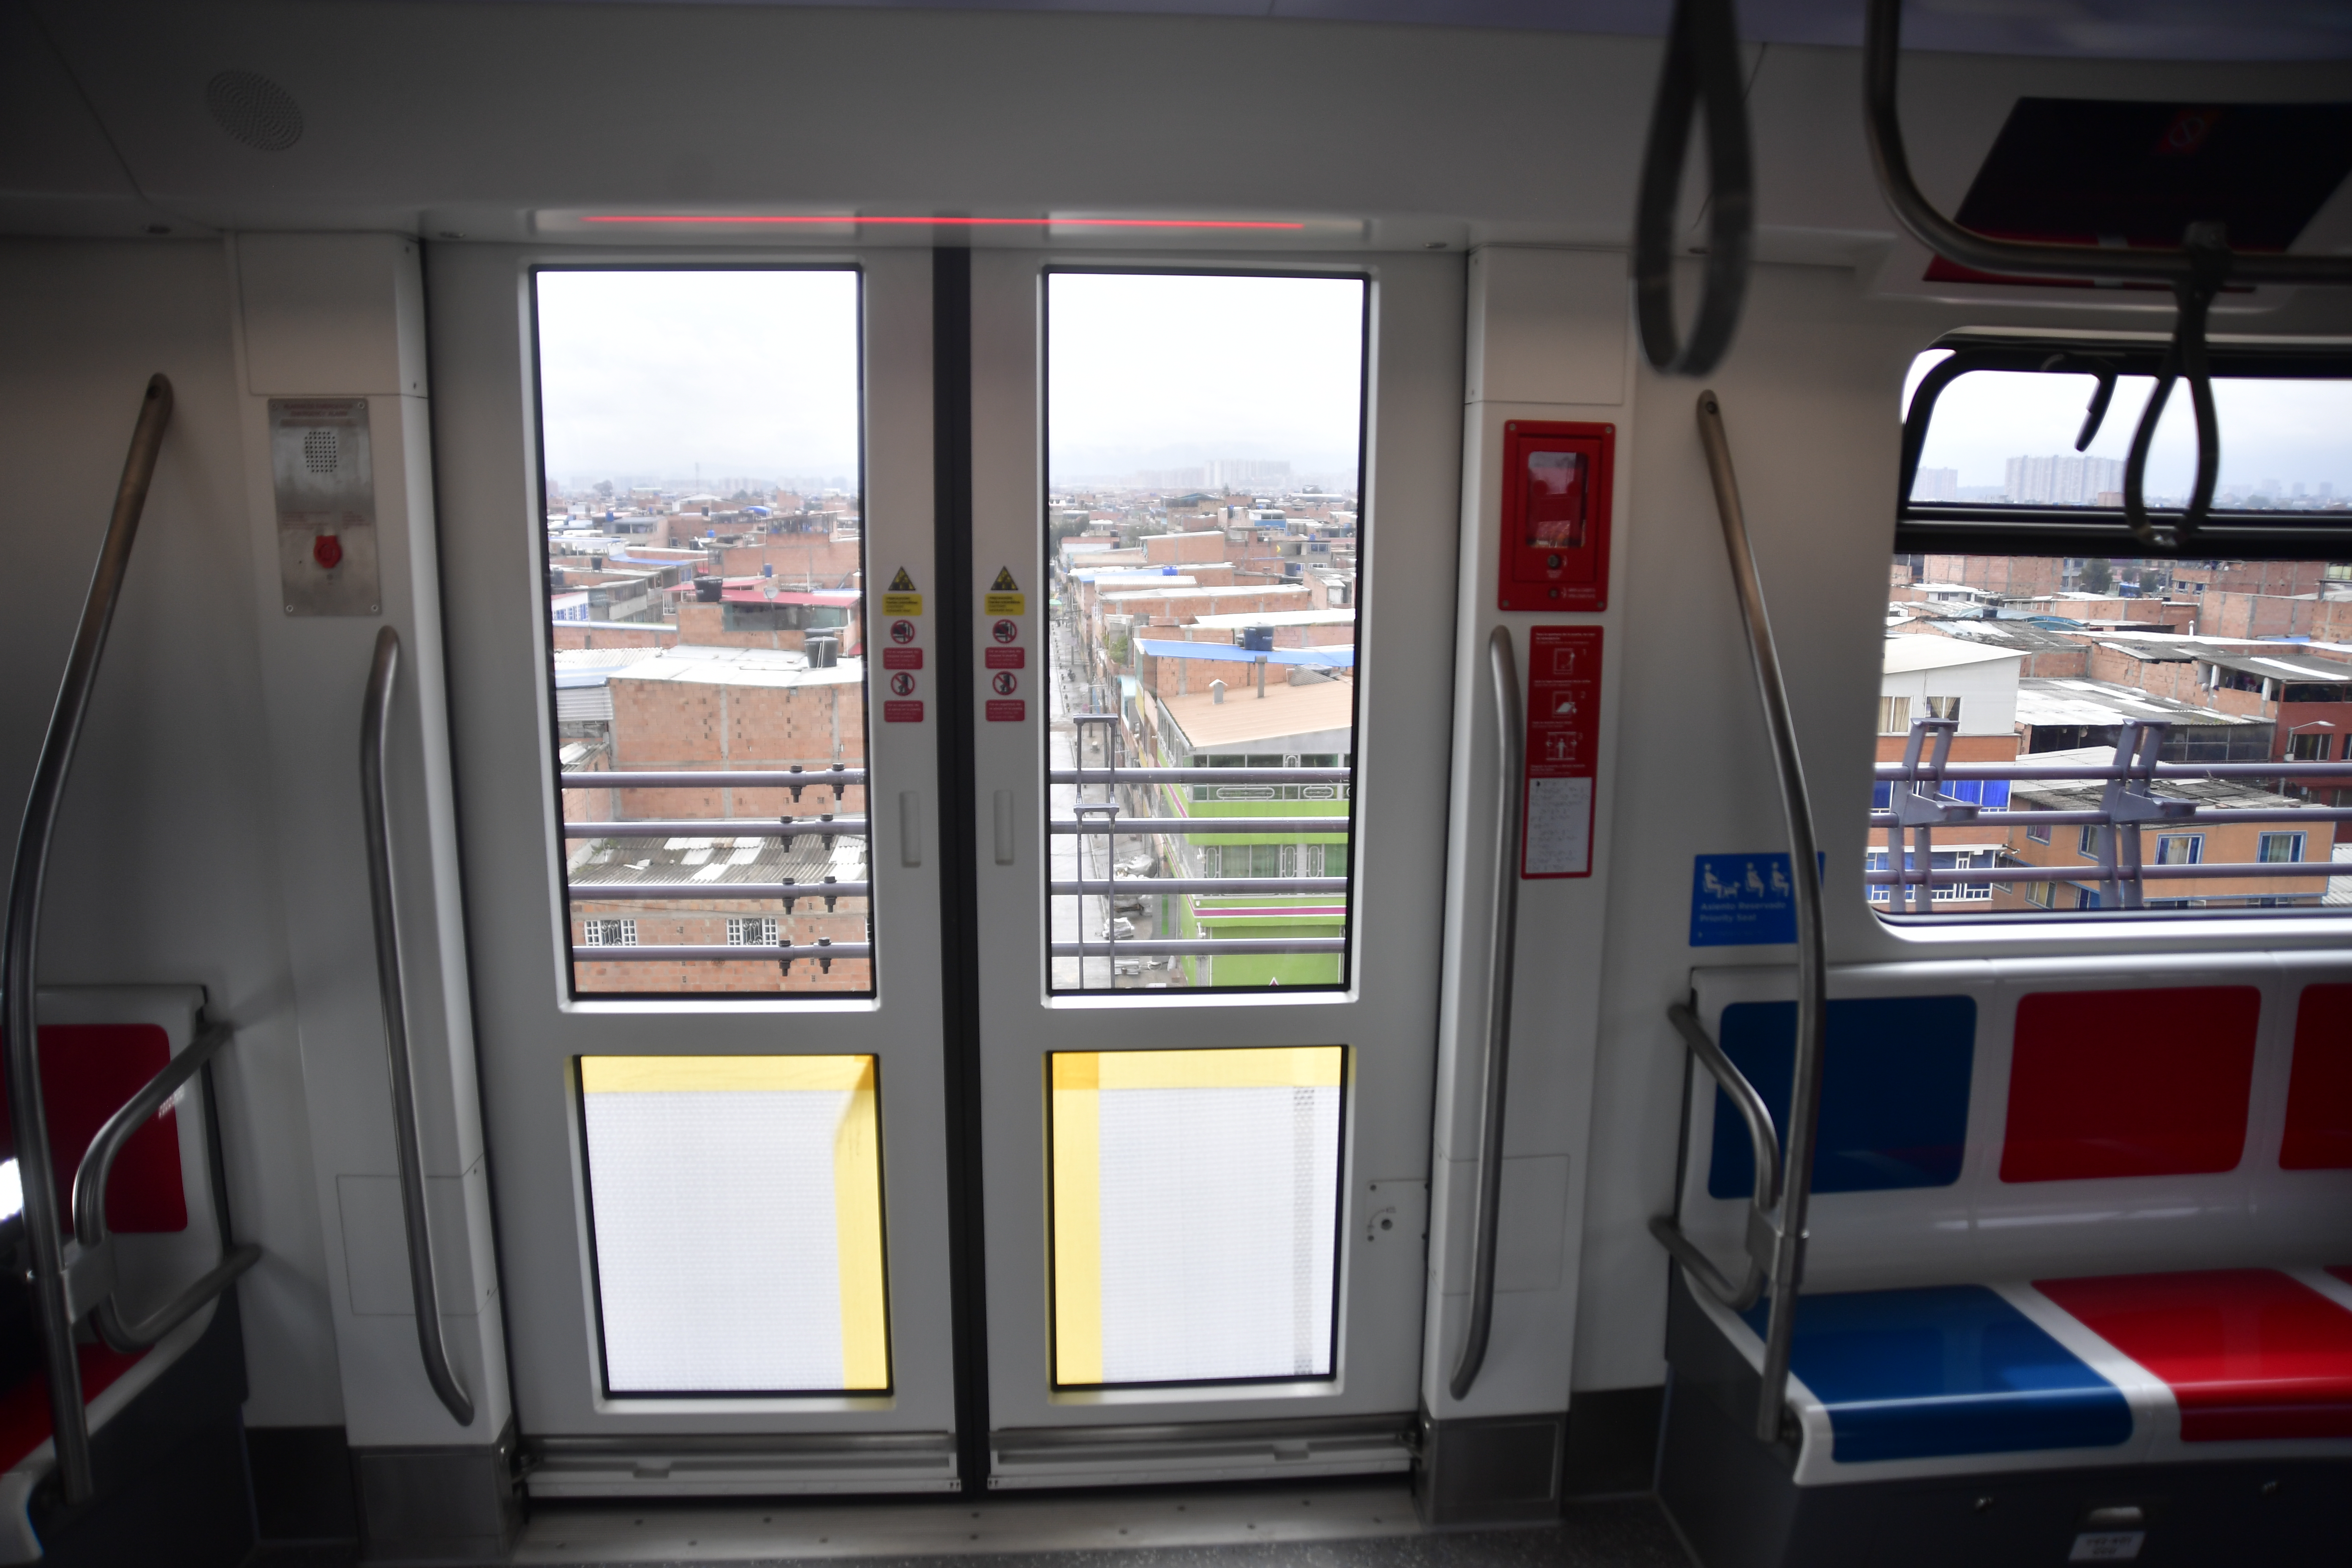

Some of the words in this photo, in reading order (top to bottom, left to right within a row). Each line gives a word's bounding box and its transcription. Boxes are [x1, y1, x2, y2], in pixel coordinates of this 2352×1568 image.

[1701, 903, 1736, 911] Asiento
[1738, 901, 1786, 909] Reservado
[1699, 914, 1733, 923] Priority
[1737, 913, 1756, 921] Seat
